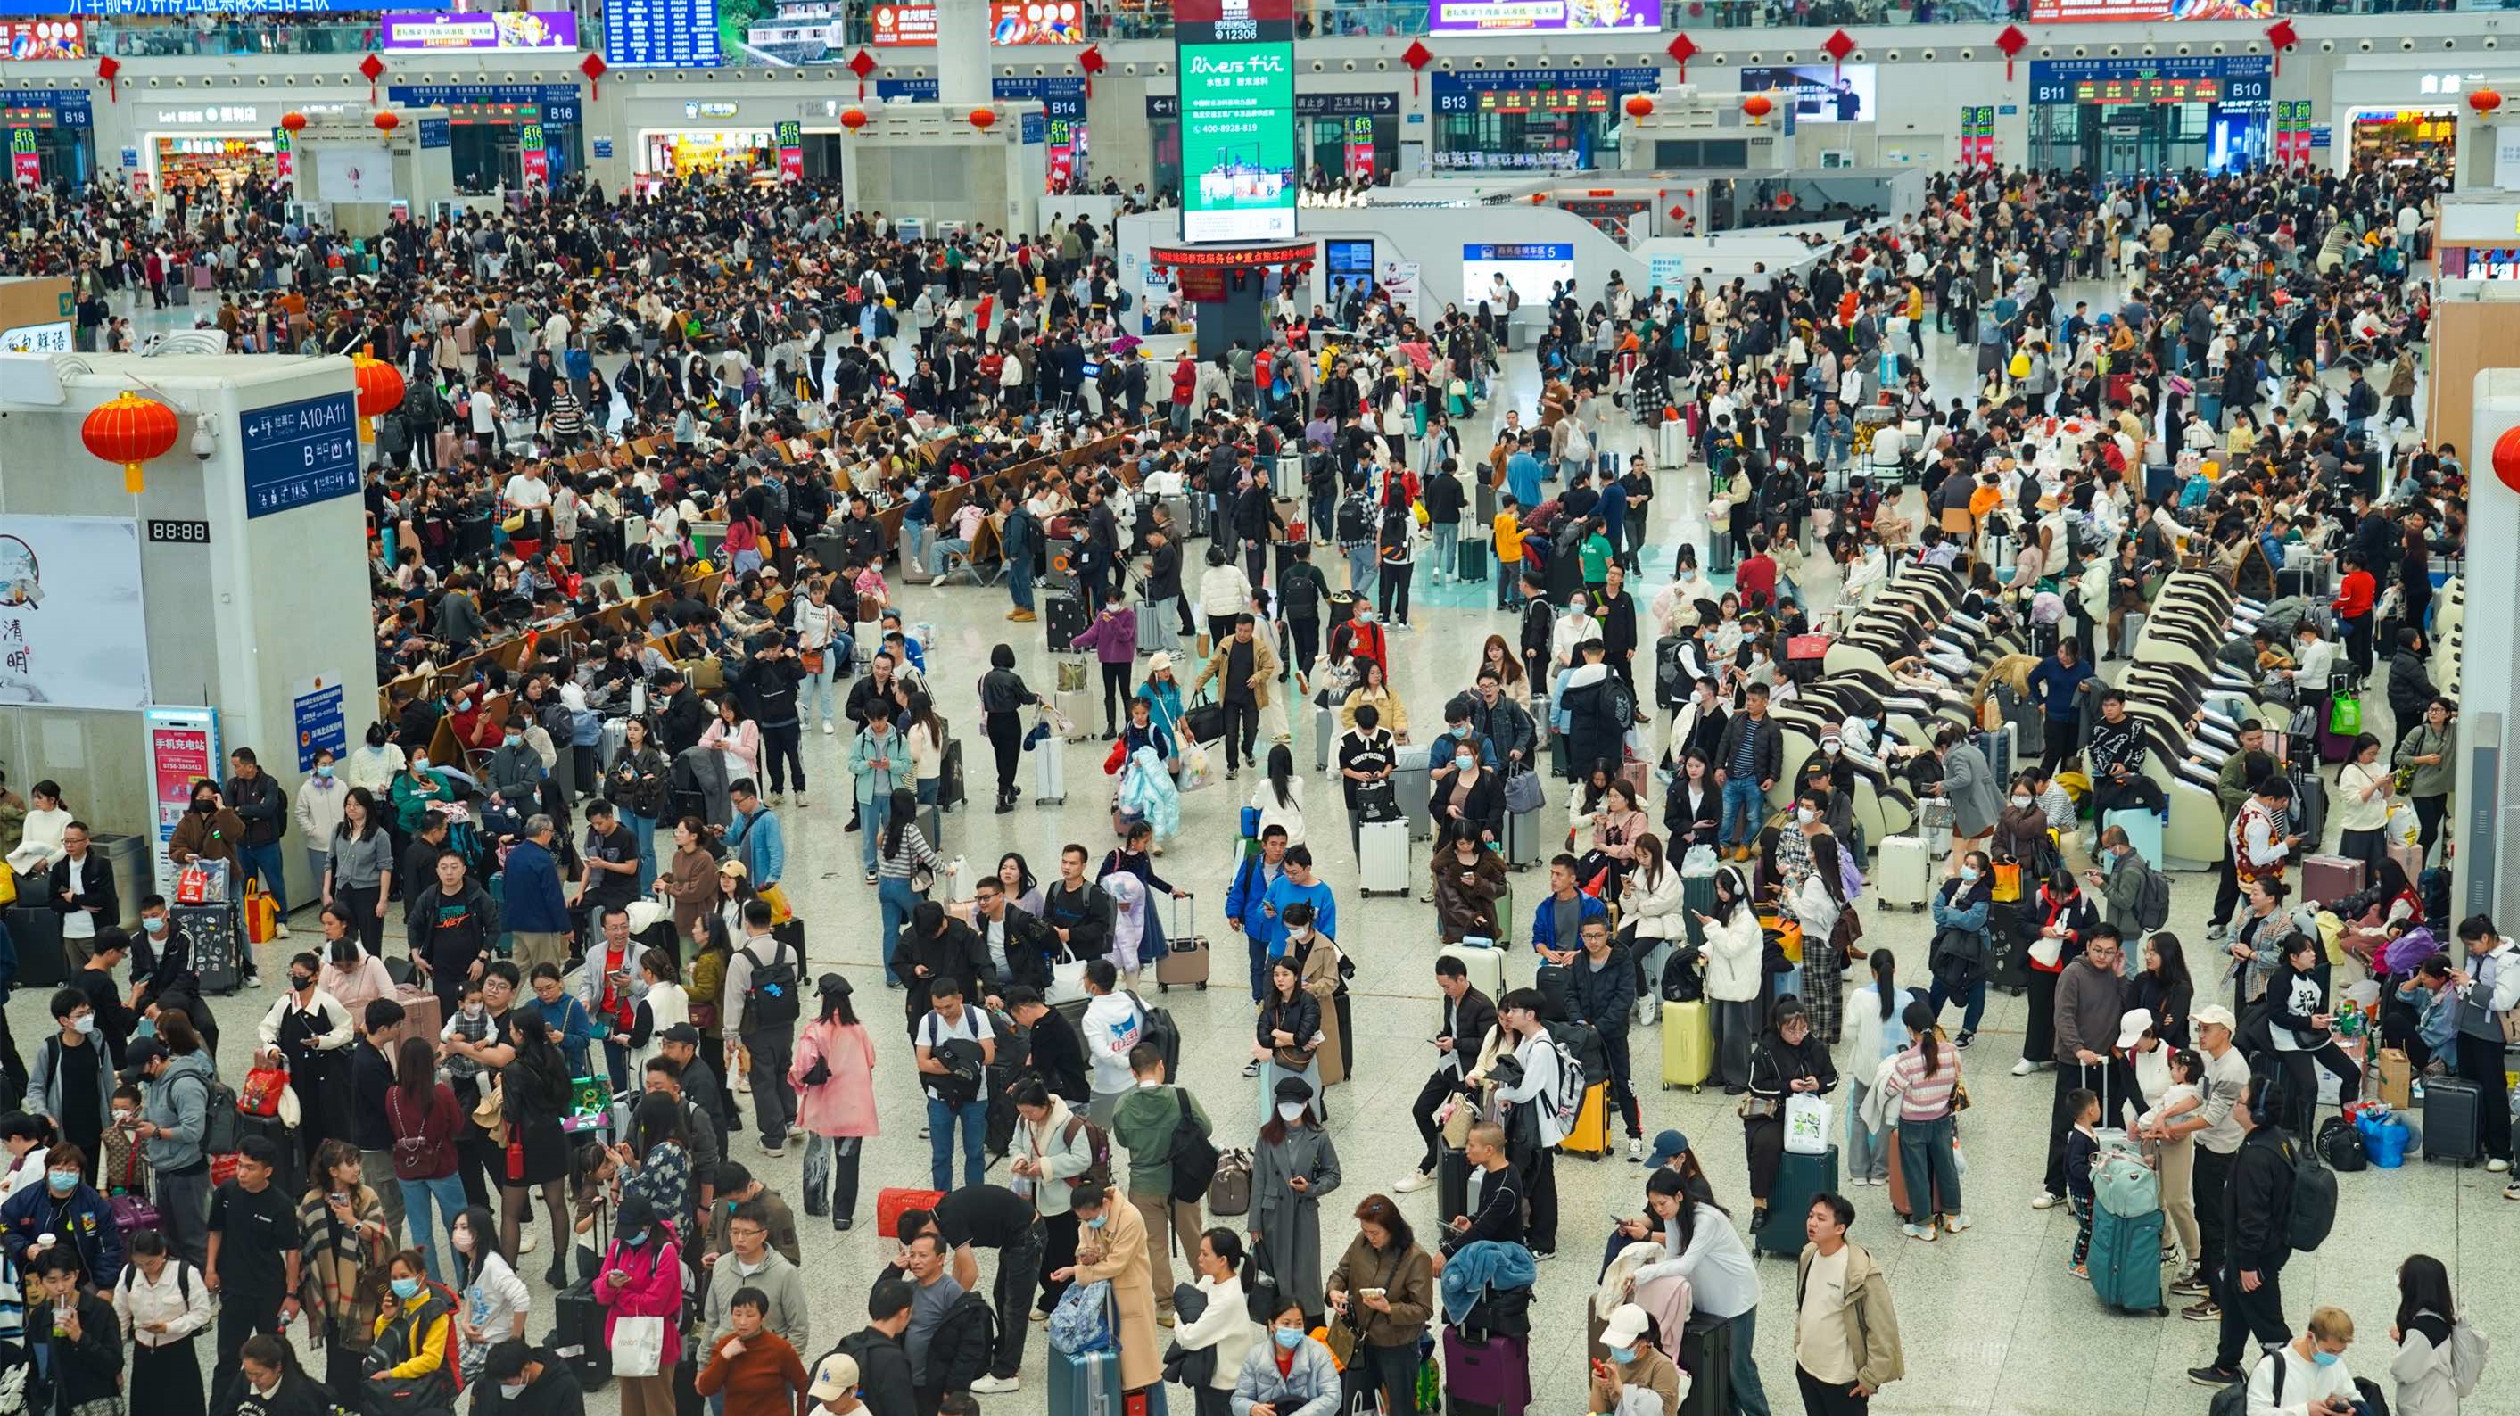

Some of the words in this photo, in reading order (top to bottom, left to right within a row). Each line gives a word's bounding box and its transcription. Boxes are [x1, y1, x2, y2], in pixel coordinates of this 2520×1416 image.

[1225, 29, 1257, 39] 12306
[2040, 86, 2065, 100] B11
[2233, 83, 2262, 96] B10
[1052, 102, 1076, 114] B14
[1442, 96, 1467, 109] B13
[550, 107, 573, 119] B16
[1977, 109, 1994, 123] B11
[2295, 103, 2310, 117] B10
[65, 111, 86, 123] B18
[1051, 123, 1068, 134] B14
[1355, 118, 1372, 132] B13
[1547, 246, 1556, 258] 5
[304, 445, 314, 467] B
[152, 522, 204, 541] 88:88
[3, 618, 28, 675] 清明
[155, 738, 205, 751] 手机充电站
